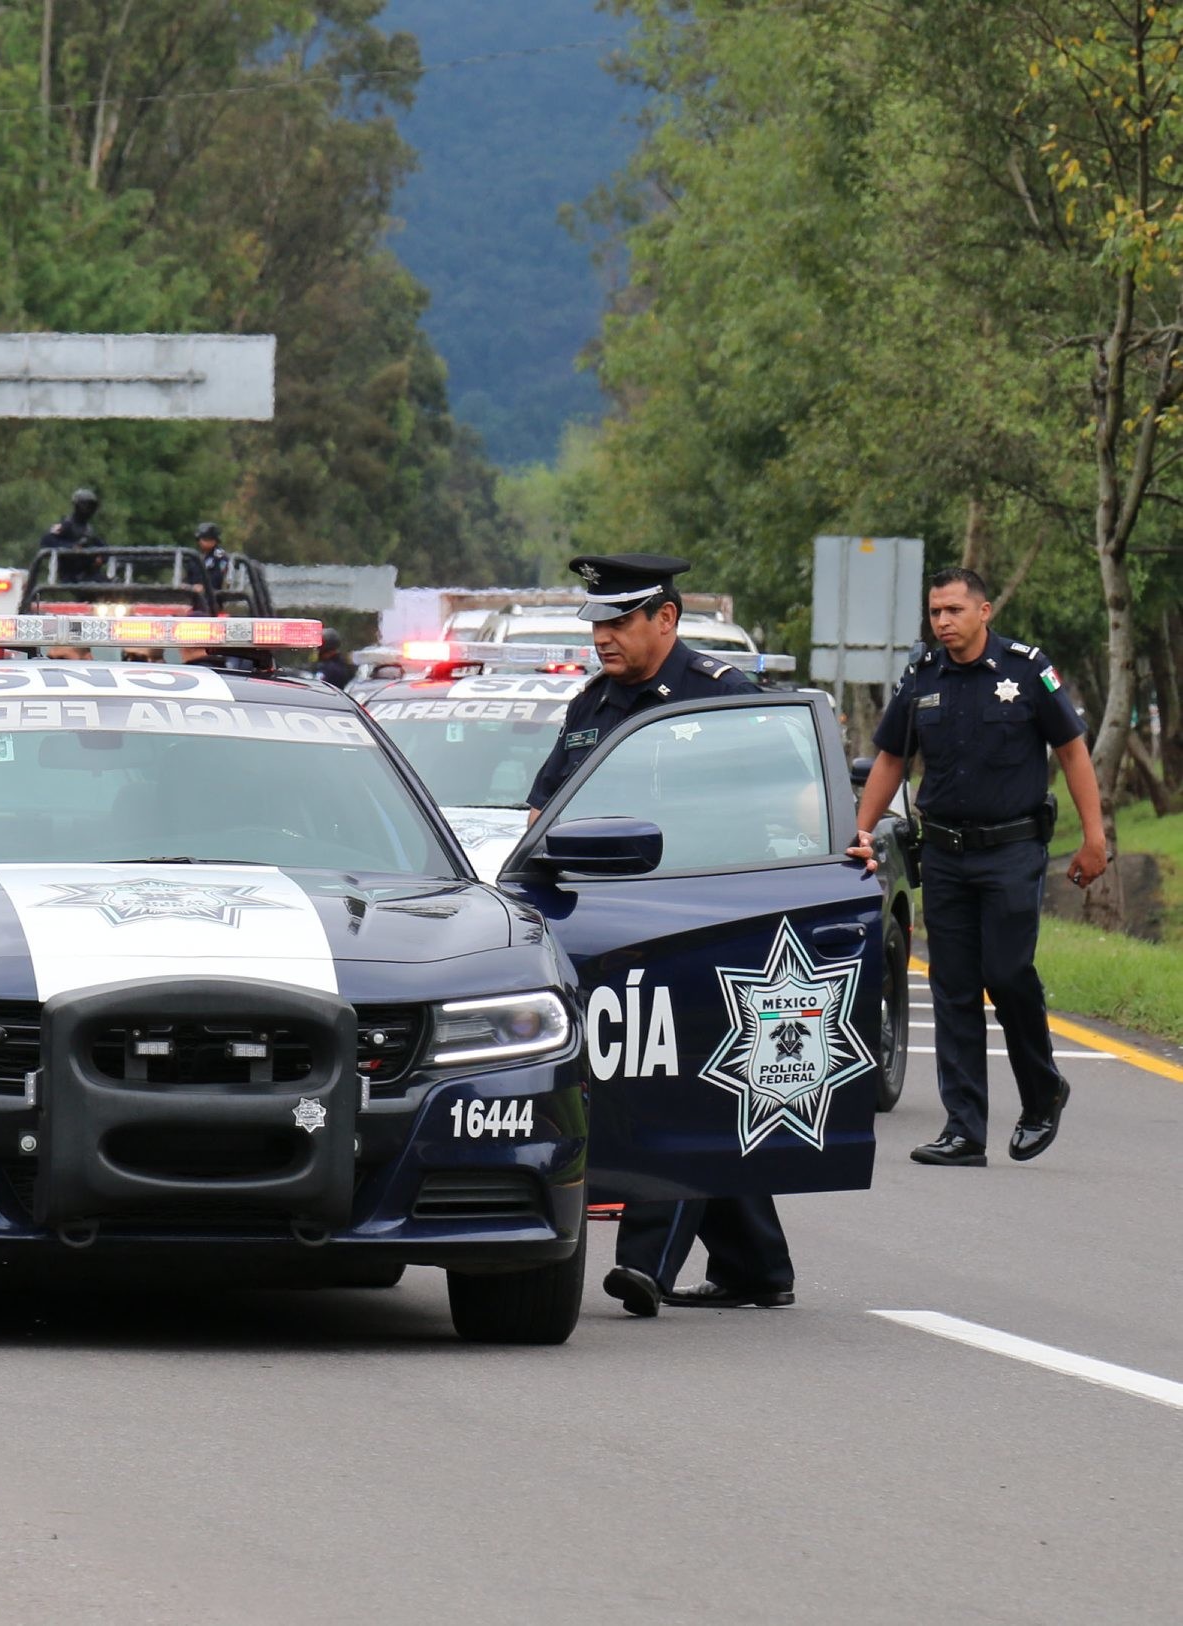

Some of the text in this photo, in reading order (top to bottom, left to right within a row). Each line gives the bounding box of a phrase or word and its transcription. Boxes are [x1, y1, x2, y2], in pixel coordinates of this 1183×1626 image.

[762, 995, 817, 1010] MÉXICO
[587, 968, 679, 1081] CÍA
[760, 1061, 815, 1074] POLICÍA
[759, 1073, 815, 1085] FEDERAL
[450, 1099, 534, 1138] 16444
